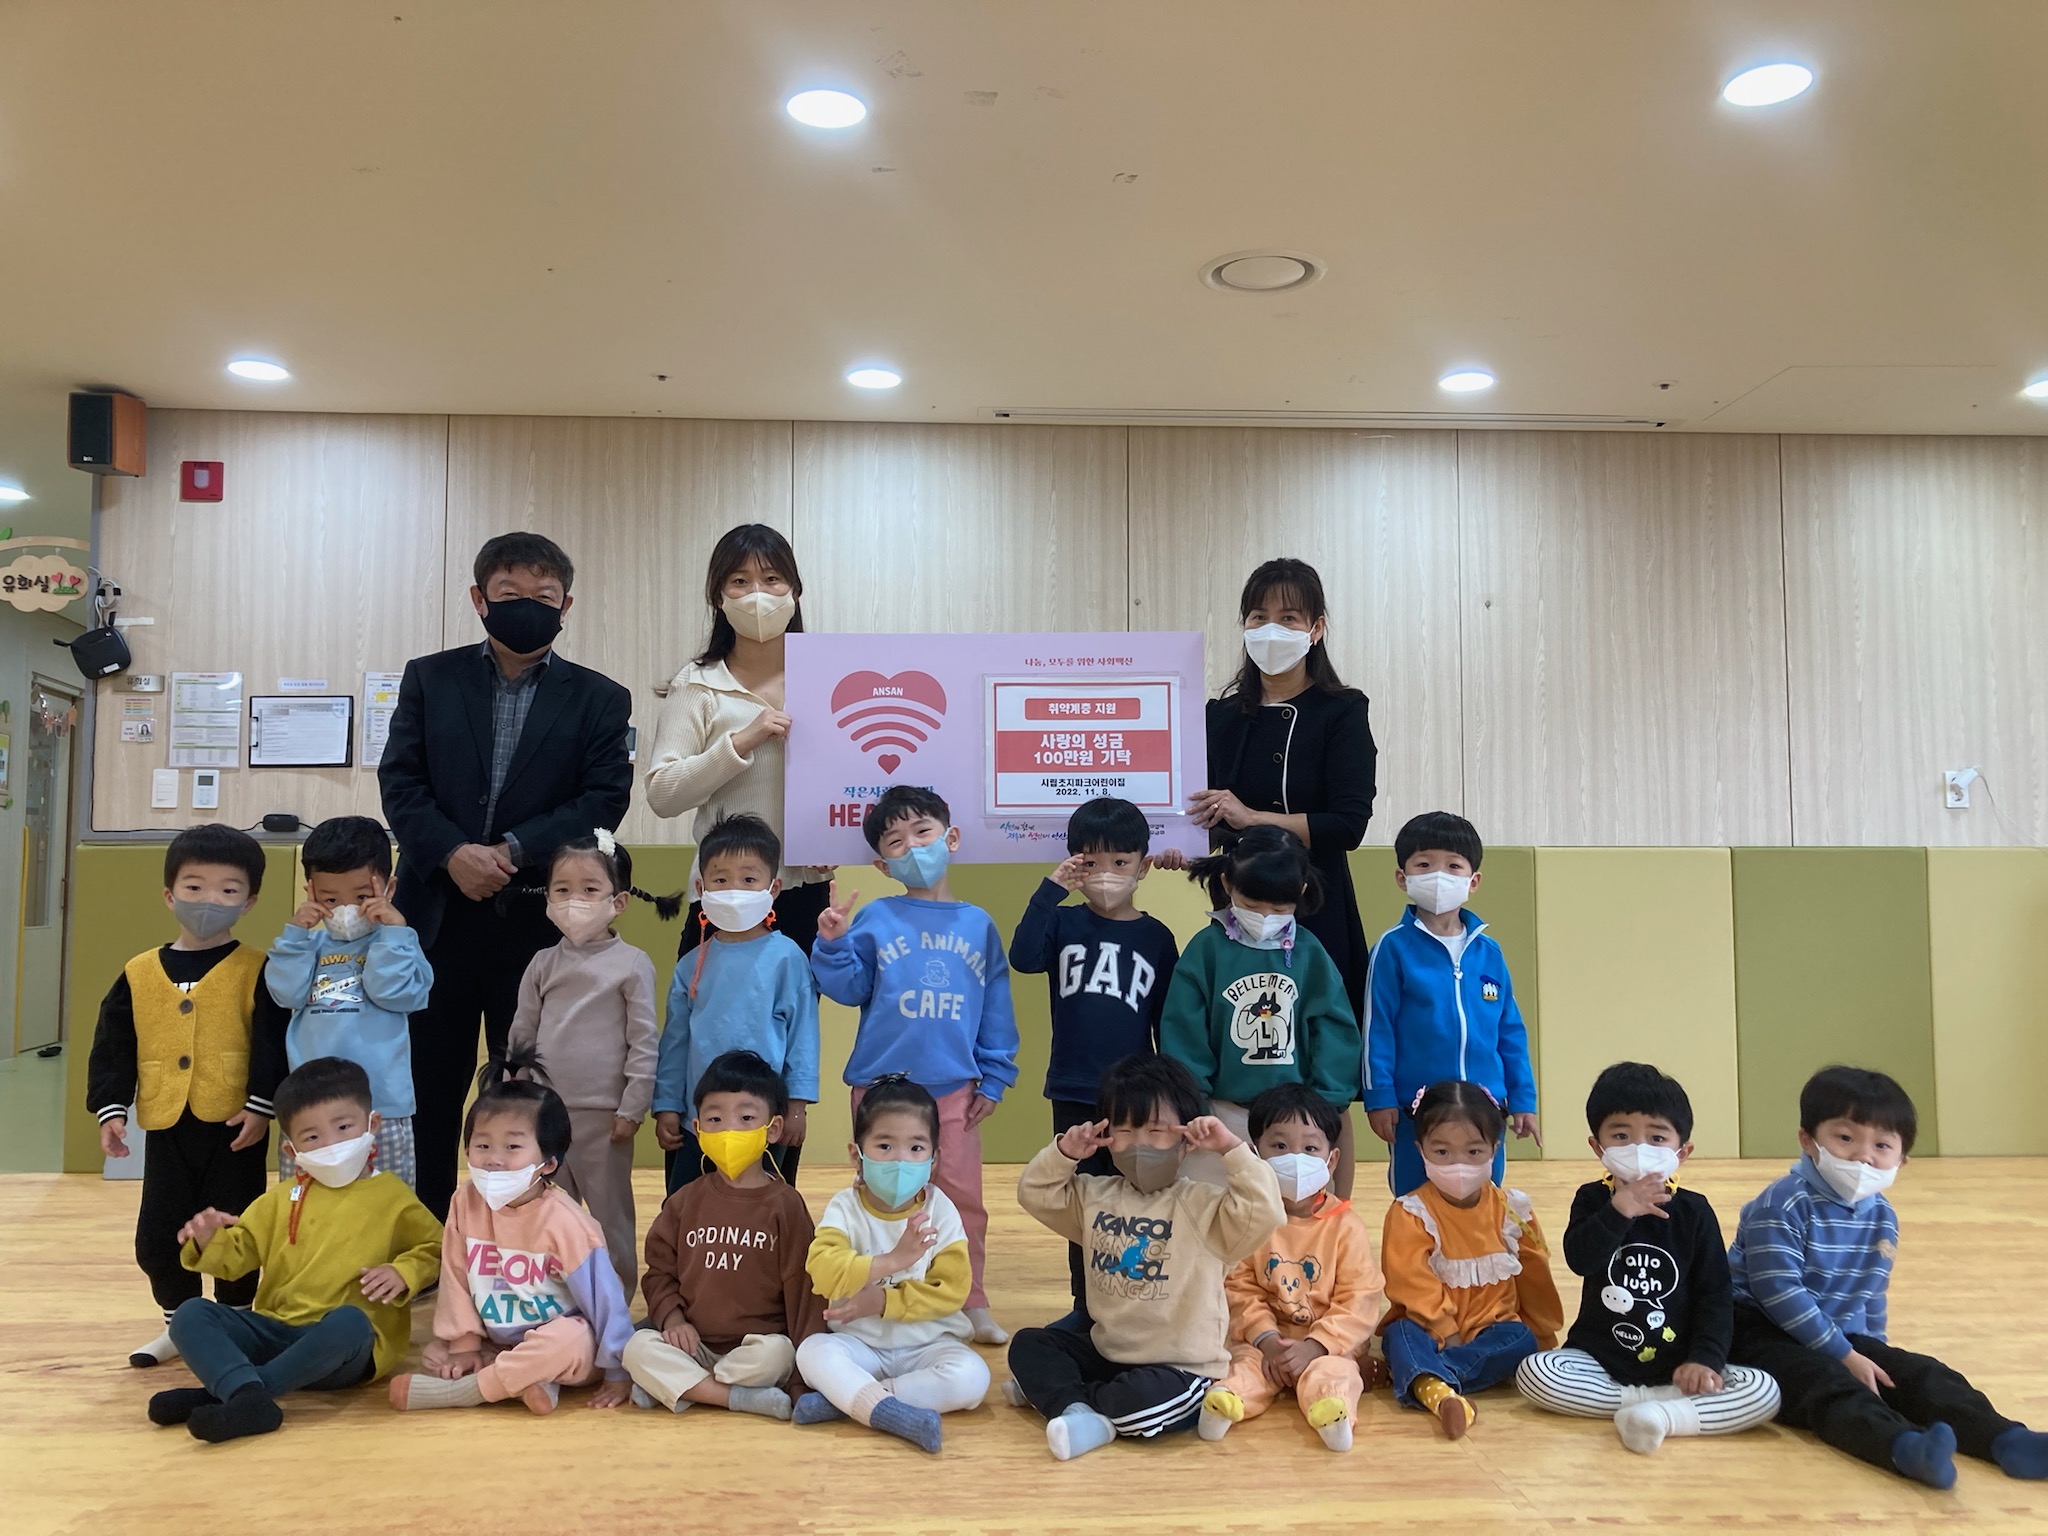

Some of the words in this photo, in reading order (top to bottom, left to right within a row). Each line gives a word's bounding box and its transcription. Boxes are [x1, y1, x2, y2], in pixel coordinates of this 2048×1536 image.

[3, 574, 50, 594] 유희실
[1024, 658, 1047, 667] 나눔,
[1048, 658, 1074, 667] 모두를
[1076, 657, 1095, 667] 위한
[872, 687, 904, 697] ANSAN
[1048, 703, 1092, 715] 취약계층
[1095, 703, 1117, 715] 지원
[1040, 734, 1086, 750] 사랑의
[1093, 733, 1125, 749] 성금
[1034, 750, 1094, 766] 100만원
[1101, 750, 1132, 765] 기탁
[1041, 778, 1126, 788] 시립초지파크어린이집
[1055, 788, 1081, 796] 2022.
[1085, 788, 1099, 796] 11.
[1102, 788, 1112, 796] 8.
[1060, 941, 1156, 1014] GAP
[899, 989, 965, 1020] CAFE
[1261, 1021, 1271, 1039] L
[1092, 1210, 1173, 1240] KANGOL
[686, 1226, 778, 1251] ORDINARY
[705, 1251, 743, 1271] DAY
[1625, 1253, 1661, 1269] allo
[1638, 1267, 1648, 1279] &
[1091, 1268, 1169, 1301] KANGOL
[1623, 1273, 1662, 1295] lugh
[1615, 1329, 1641, 1341] HELLO!
